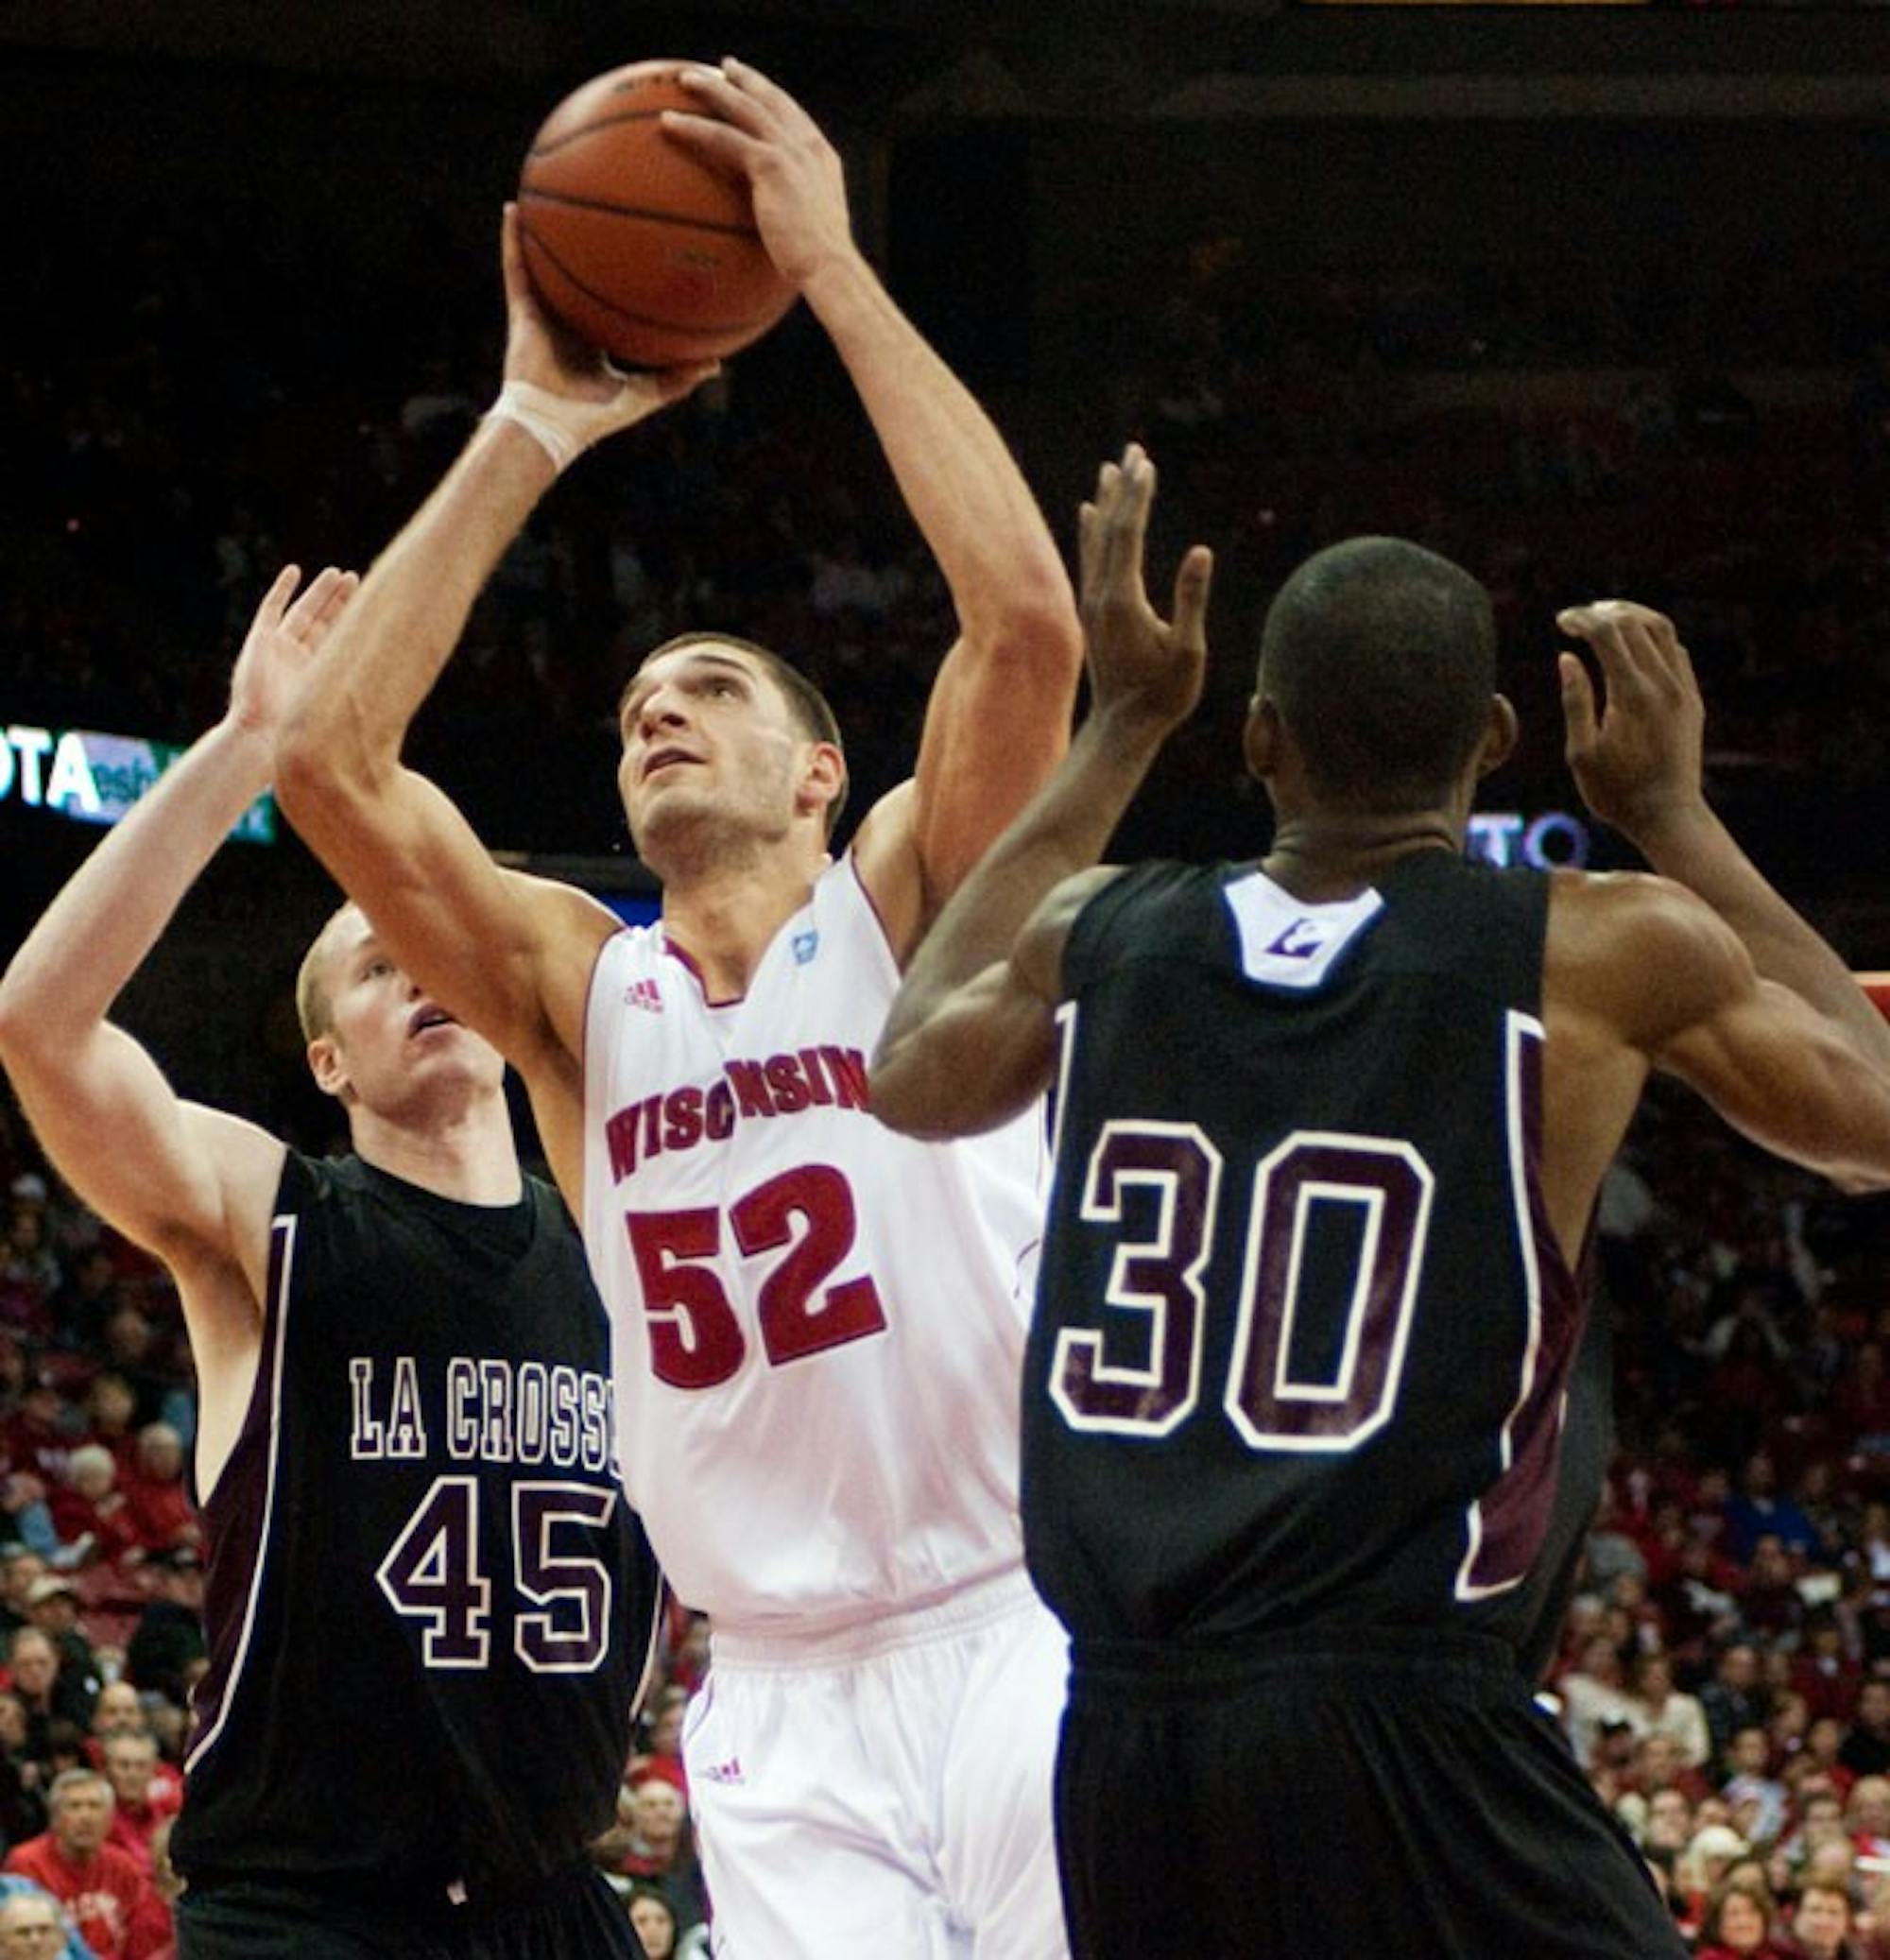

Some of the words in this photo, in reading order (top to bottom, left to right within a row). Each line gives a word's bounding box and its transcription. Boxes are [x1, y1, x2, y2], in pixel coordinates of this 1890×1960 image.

[625, 1163, 887, 1390] 52
[1049, 1119, 1435, 1452] 30
[350, 1356, 426, 1459] LA
[447, 1357, 624, 1480] CROSS
[375, 1475, 617, 1674] 45
